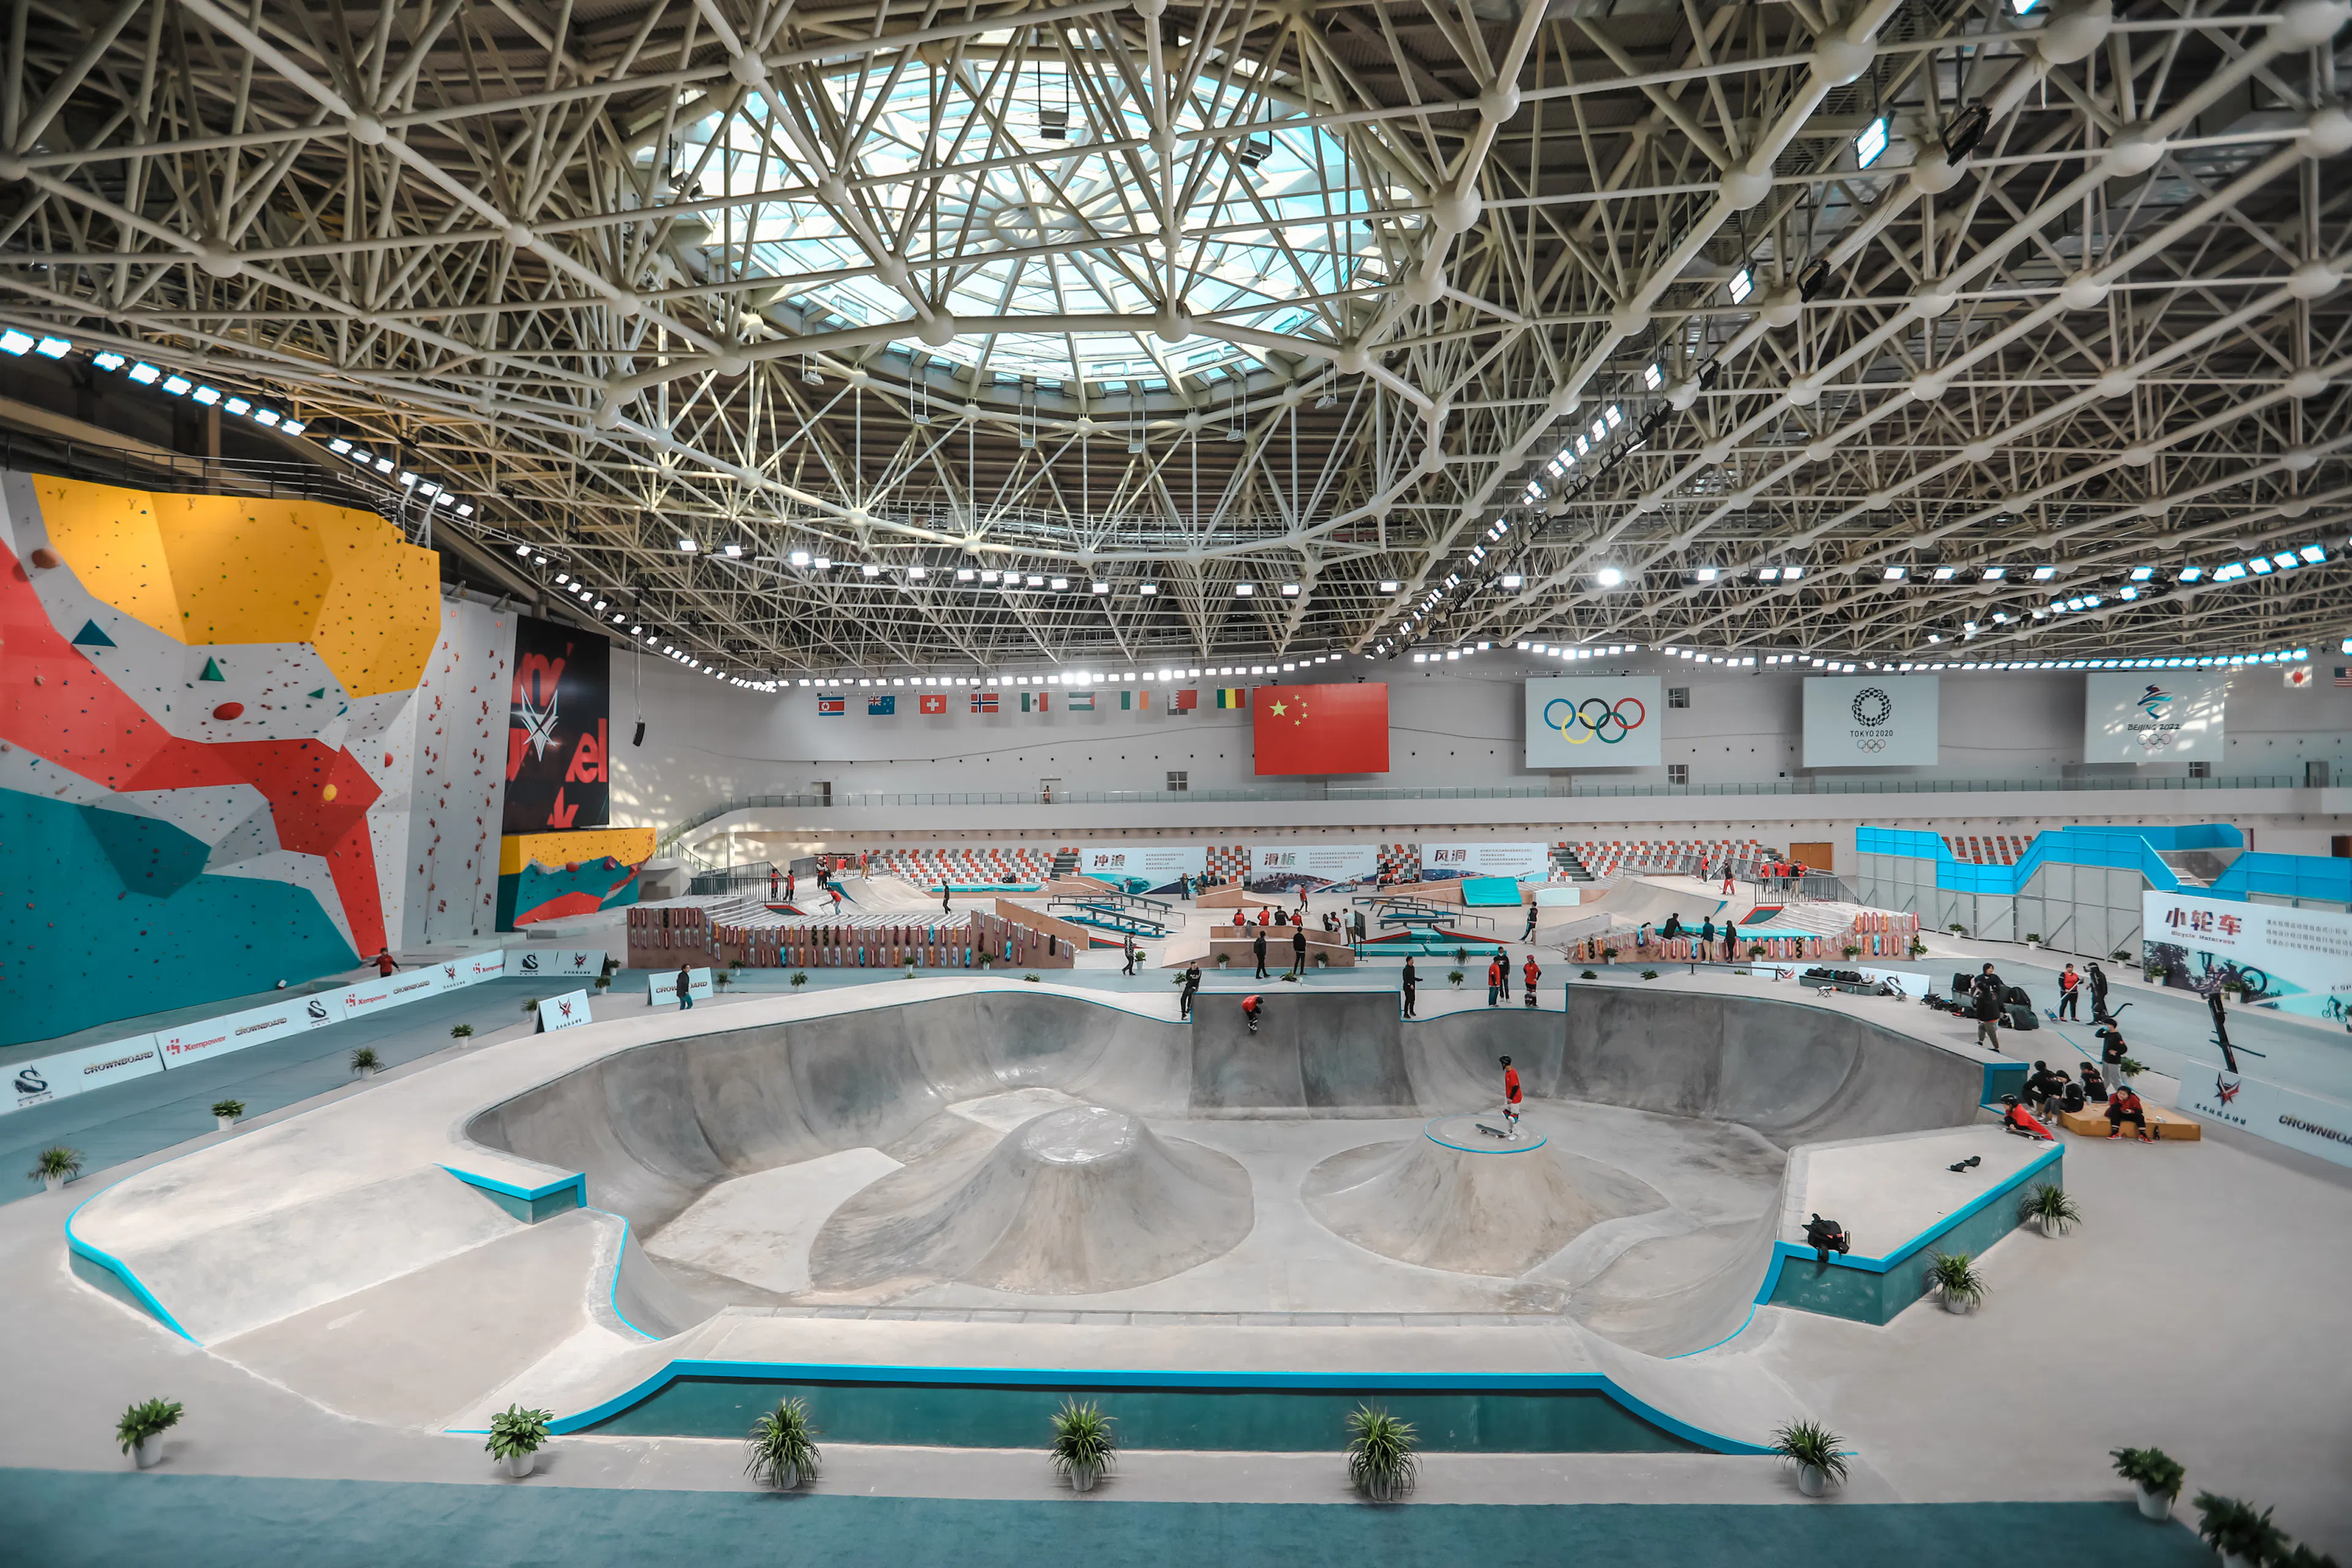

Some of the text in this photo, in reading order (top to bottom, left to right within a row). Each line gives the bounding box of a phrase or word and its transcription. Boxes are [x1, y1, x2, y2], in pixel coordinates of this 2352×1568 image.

[2127, 724, 2156, 733] BEIJING
[1094, 854, 1125, 867] 冲浪
[1264, 853, 1296, 865] 滑板
[1434, 850, 1466, 862] 风洞
[2165, 907, 2242, 936] 小轮车
[2199, 935, 2235, 945] Motocross
[393, 981, 430, 994] CROWNBOARD
[358, 994, 387, 1005] Xempower
[235, 1017, 287, 1036] CROWNBOARD
[184, 1036, 226, 1052] Xempower
[84, 1051, 153, 1074] CROWNBOARD
